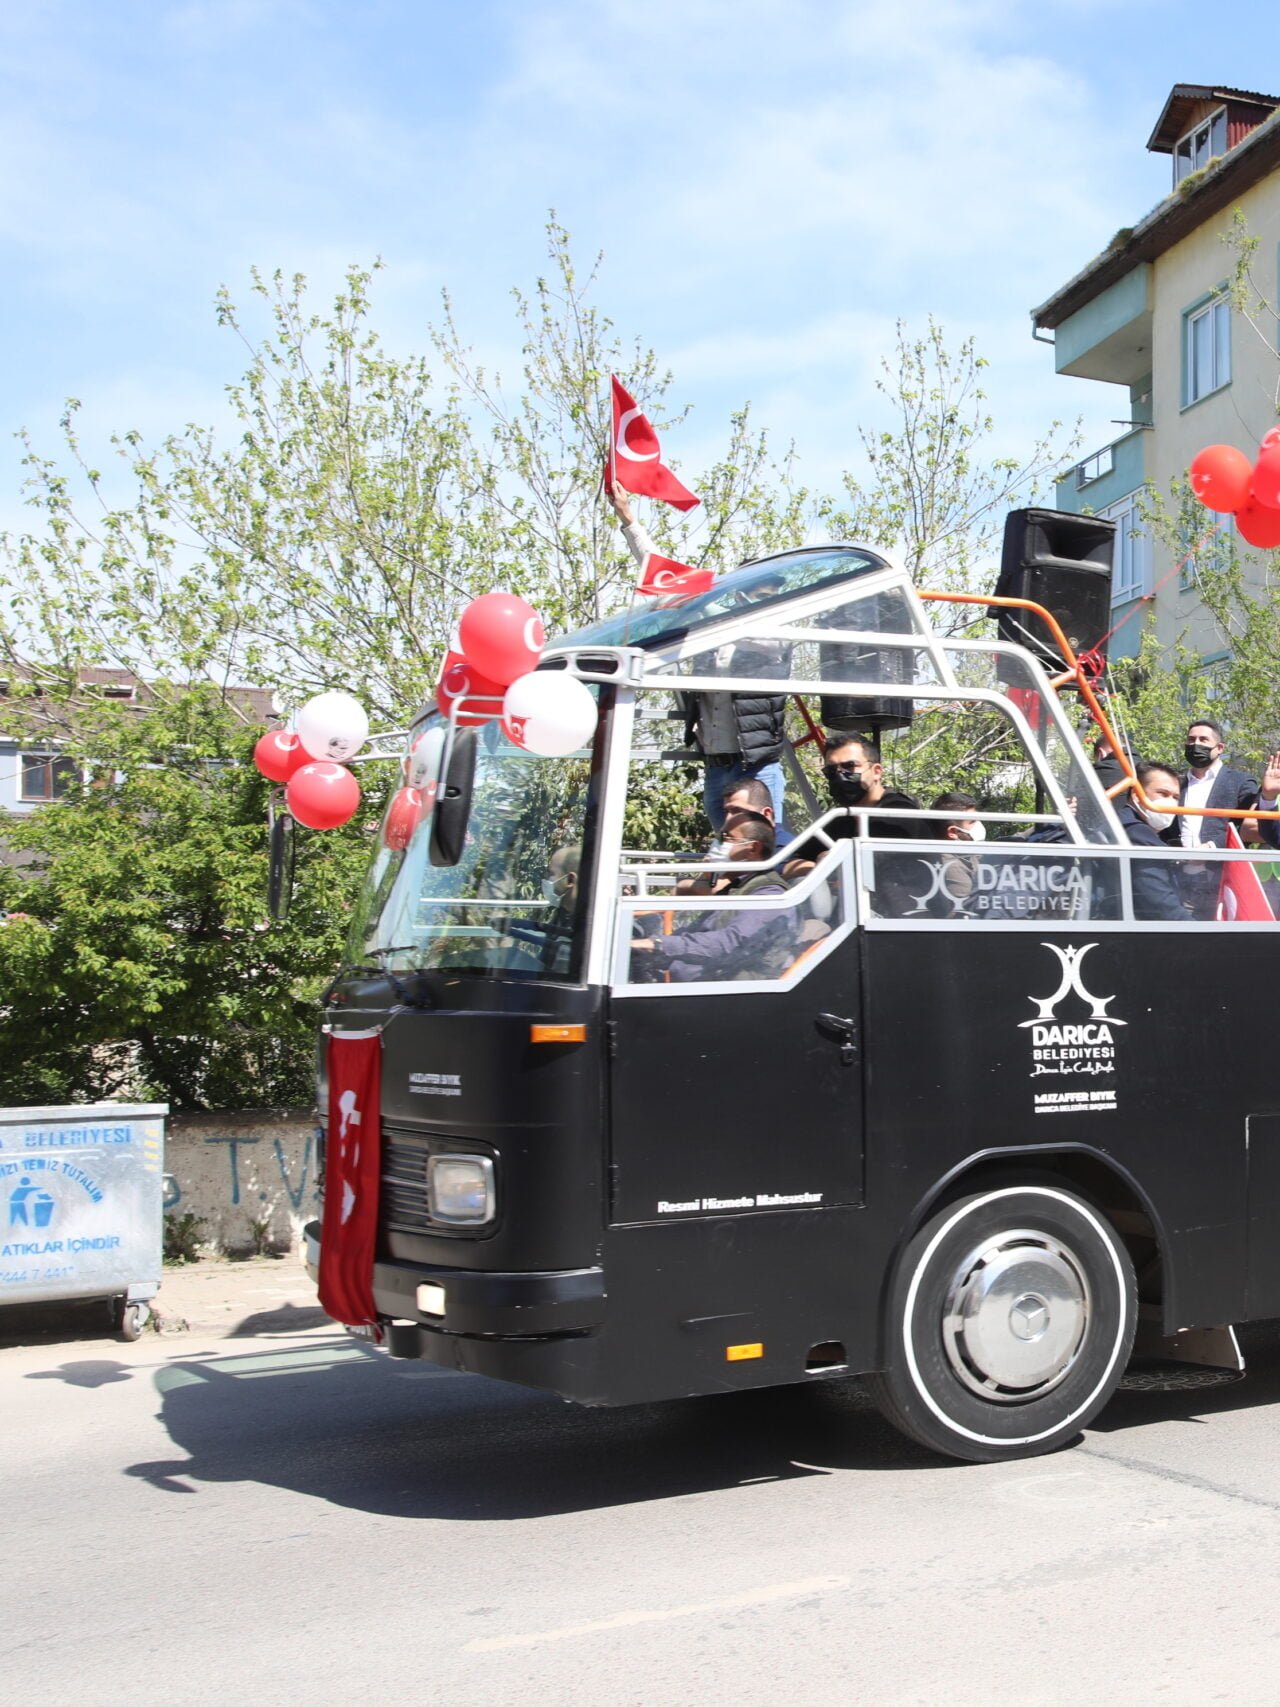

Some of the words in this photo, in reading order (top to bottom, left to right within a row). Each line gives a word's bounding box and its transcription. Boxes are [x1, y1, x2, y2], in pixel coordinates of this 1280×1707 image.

[978, 864, 1087, 892] DARICA
[1032, 1024, 1114, 1046] DARICA
[657, 1199, 700, 1213] Resmi
[702, 1197, 754, 1210] Hizmete
[1, 1240, 63, 1256] ATIKLAR
